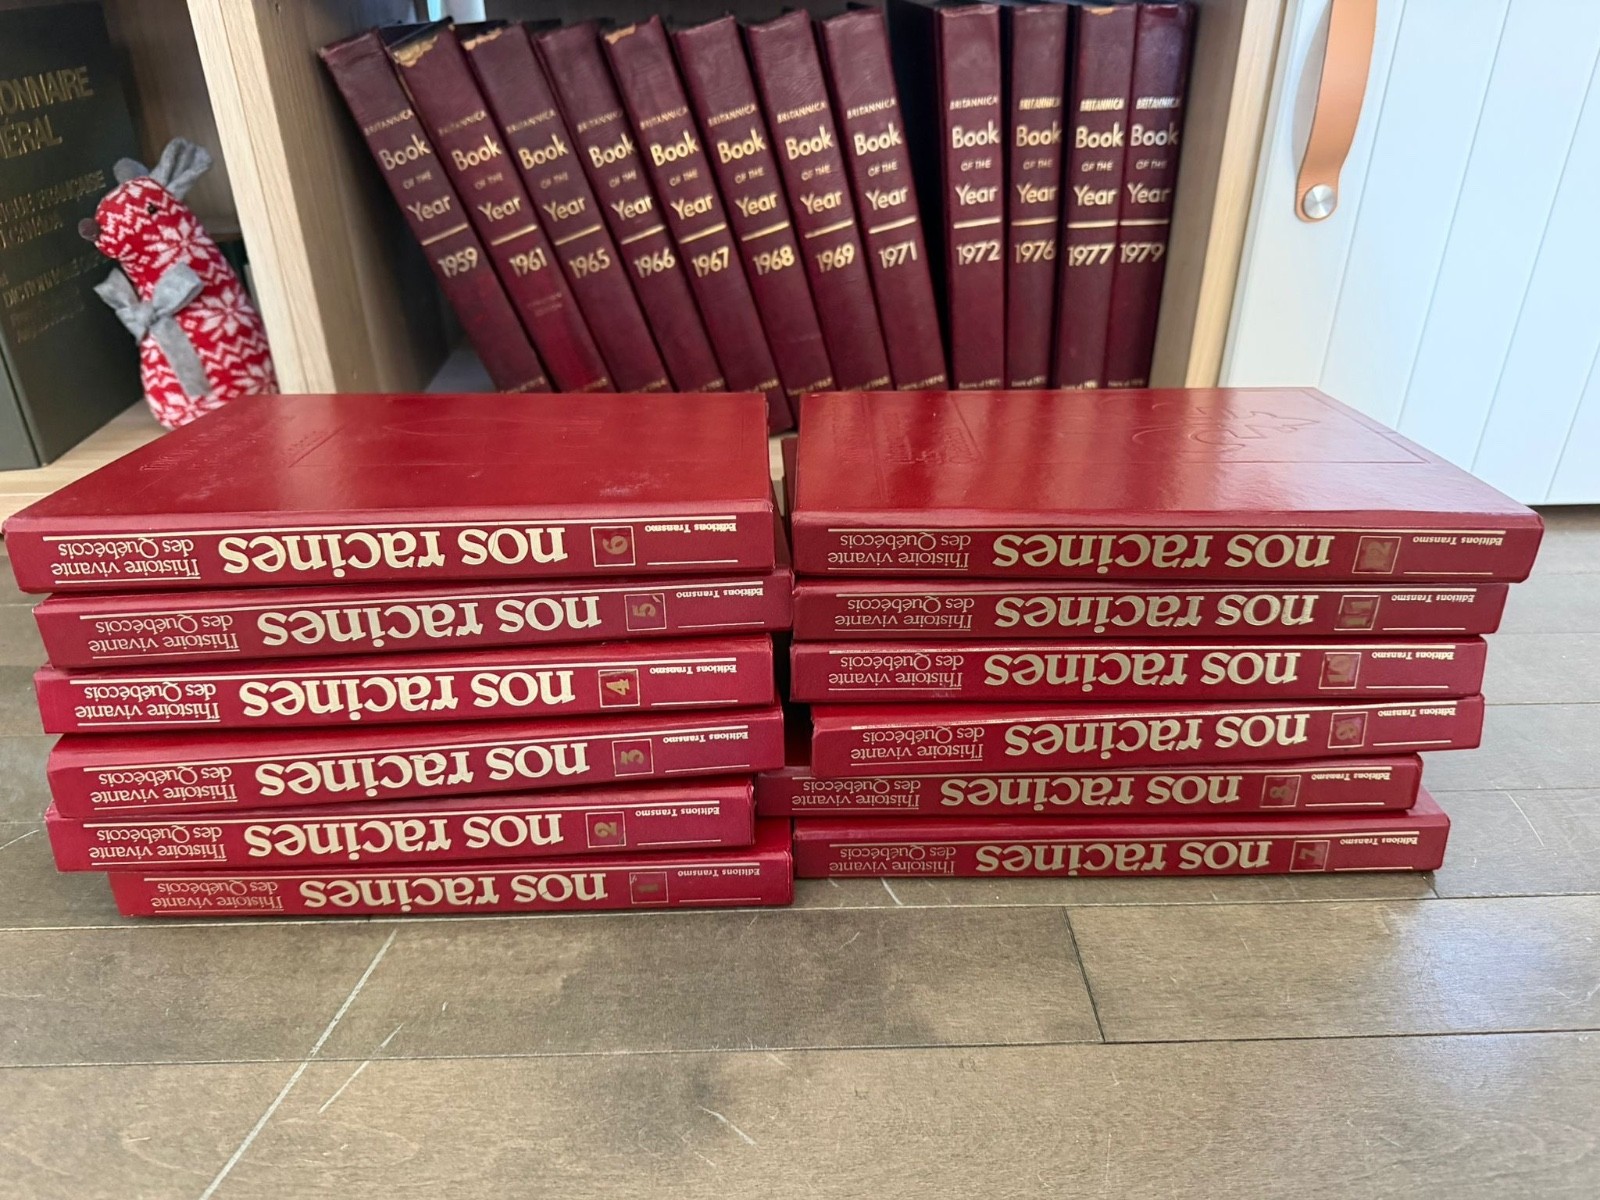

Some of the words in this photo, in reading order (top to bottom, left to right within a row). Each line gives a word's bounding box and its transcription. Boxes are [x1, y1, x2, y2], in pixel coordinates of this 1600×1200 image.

[0, 66, 95, 116] ONNAIRE
[949, 95, 999, 110] BRITANNICA
[846, 97, 896, 120] BRITANNICA
[1080, 97, 1125, 112] BRITANNICA
[785, 124, 834, 160] Book
[853, 121, 902, 156] Book
[952, 120, 1000, 149] Book
[1016, 121, 1062, 147] Book
[1075, 121, 1124, 149] Book
[1130, 122, 1179, 147] Book
[378, 134, 431, 171] Book
[451, 134, 502, 171] Book
[518, 133, 569, 170] Book
[588, 133, 635, 168] Book
[649, 130, 699, 167] Book
[717, 128, 767, 164] Book
[735, 191, 778, 218] Year
[800, 190, 843, 216] Year
[865, 187, 908, 210] Year
[955, 183, 998, 205] Year
[1016, 182, 1057, 205] Year
[1074, 183, 1116, 206] Year
[1127, 182, 1170, 204] Year
[407, 195, 451, 222] Year
[478, 196, 520, 222] Year
[543, 196, 586, 222] Year
[611, 195, 653, 220] Year
[670, 194, 713, 220] Year
[438, 247, 479, 279] 1959
[509, 247, 548, 279] 1961
[691, 246, 730, 278] 1967
[753, 245, 795, 275] 1968
[816, 244, 855, 274] 1969
[879, 242, 918, 268] 1971
[956, 242, 1001, 264] 1972
[1015, 241, 1056, 262] 1976
[1067, 244, 1115, 266] 1977
[1120, 242, 1165, 264] 1979
[569, 250, 610, 280] 1965
[635, 248, 676, 279] 1966
[58, 538, 159, 558] Québécois
[163, 539, 194, 553] des
[458, 527, 568, 564] nos
[602, 535, 628, 555] 6
[840, 532, 936, 550] Québécois
[940, 533, 971, 546] des
[219, 528, 444, 578] racines
[828, 551, 892, 564] vivante
[993, 534, 1212, 574] racines
[1224, 535, 1334, 568] nos
[51, 563, 119, 577] vivante
[495, 596, 601, 632] nos
[632, 603, 656, 618] 5
[847, 595, 942, 614] Québécois
[946, 598, 974, 611] des
[994, 595, 1203, 633] racines
[1215, 594, 1319, 626] nos
[96, 614, 198, 633] Québécois
[201, 615, 233, 631] des
[257, 602, 483, 647] racines
[835, 614, 898, 626] vivante
[88, 637, 158, 652] vivante
[840, 653, 931, 670] Québécois
[935, 654, 964, 668] des
[984, 653, 1188, 692] racines
[1200, 652, 1301, 685] nos
[470, 671, 576, 706] nos
[606, 679, 630, 695] 4
[828, 672, 889, 684] vivante
[84, 682, 182, 701] Québécois
[185, 683, 217, 699] des
[239, 675, 458, 720] racines
[75, 704, 142, 720] vivante
[863, 726, 952, 743] Québécois
[957, 727, 984, 742] des
[1004, 719, 1202, 760] racines
[1215, 714, 1310, 747] nos
[486, 743, 590, 780] nos
[620, 749, 644, 764] 3
[851, 748, 912, 760] vivante
[99, 765, 198, 785] Québécois
[202, 767, 232, 782] des
[255, 751, 474, 797] racines
[90, 789, 158, 804] vivante
[803, 779, 889, 794] Québécois
[894, 780, 921, 792] des
[940, 777, 1134, 811] racines
[1146, 775, 1242, 804] nos
[792, 794, 851, 806] vivante
[97, 825, 190, 843] Québécois
[194, 826, 223, 842] des
[244, 819, 451, 860] racines
[463, 814, 563, 848] nos
[594, 822, 617, 837] 2
[89, 846, 152, 859] vivante
[840, 845, 925, 861] Québécois
[929, 847, 956, 859] des
[975, 843, 1167, 876] racines
[1178, 841, 1272, 869] nos
[829, 861, 888, 872] vivante
[158, 880, 248, 897] Québécois
[251, 881, 278, 895] des
[300, 876, 499, 912] racines
[511, 873, 607, 901] nos
[151, 896, 212, 909] vivante
